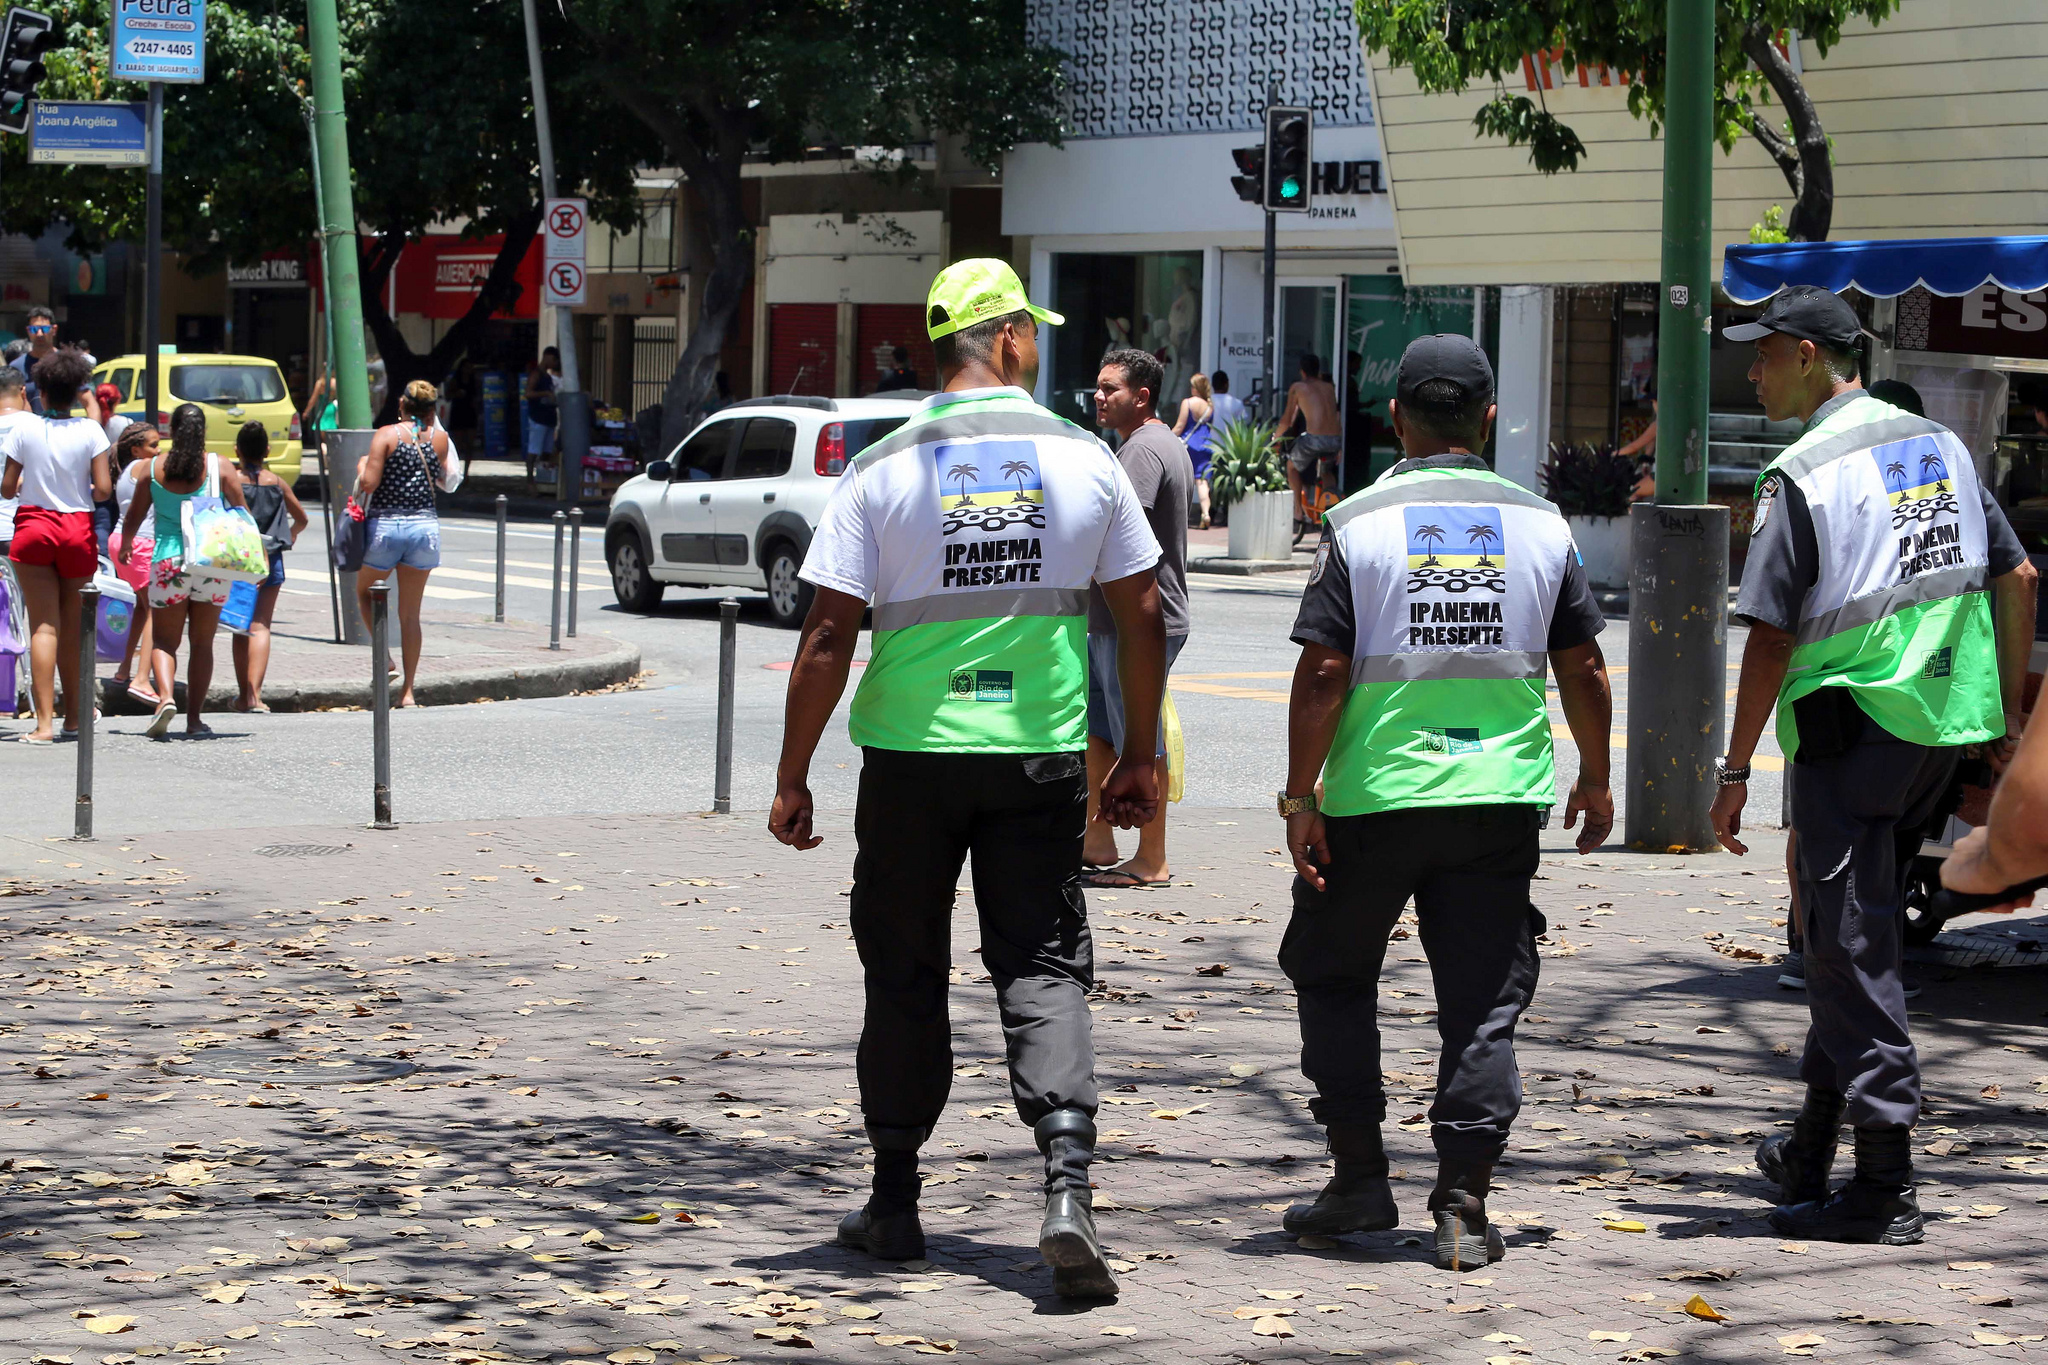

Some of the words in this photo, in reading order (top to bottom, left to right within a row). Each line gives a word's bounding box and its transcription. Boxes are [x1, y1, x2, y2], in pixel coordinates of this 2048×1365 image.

[128, 20, 158, 28] Creche
[165, 21, 192, 30] Escola
[148, 64, 155, 72] DE
[37, 104, 59, 114] Rua
[37, 115, 70, 126] Joana
[72, 115, 118, 129] Angélica
[38, 151, 56, 160] 134
[124, 153, 140, 162] 108
[1308, 207, 1357, 219] IPANEMA
[271, 259, 299, 280] KING
[436, 263, 493, 283] AMERICAN
[1899, 523, 1960, 558] IPANEMA
[945, 538, 1042, 566] IPANEMA
[1899, 545, 1965, 579] PRESENTE
[943, 563, 1042, 588] PRESENTE
[1410, 602, 1503, 624] IPANEMA
[1409, 626, 1504, 646] PRESENTE
[978, 691, 1009, 699] Janeiro
[979, 684, 991, 692] Rio
[1451, 746, 1480, 754] Janeiro
